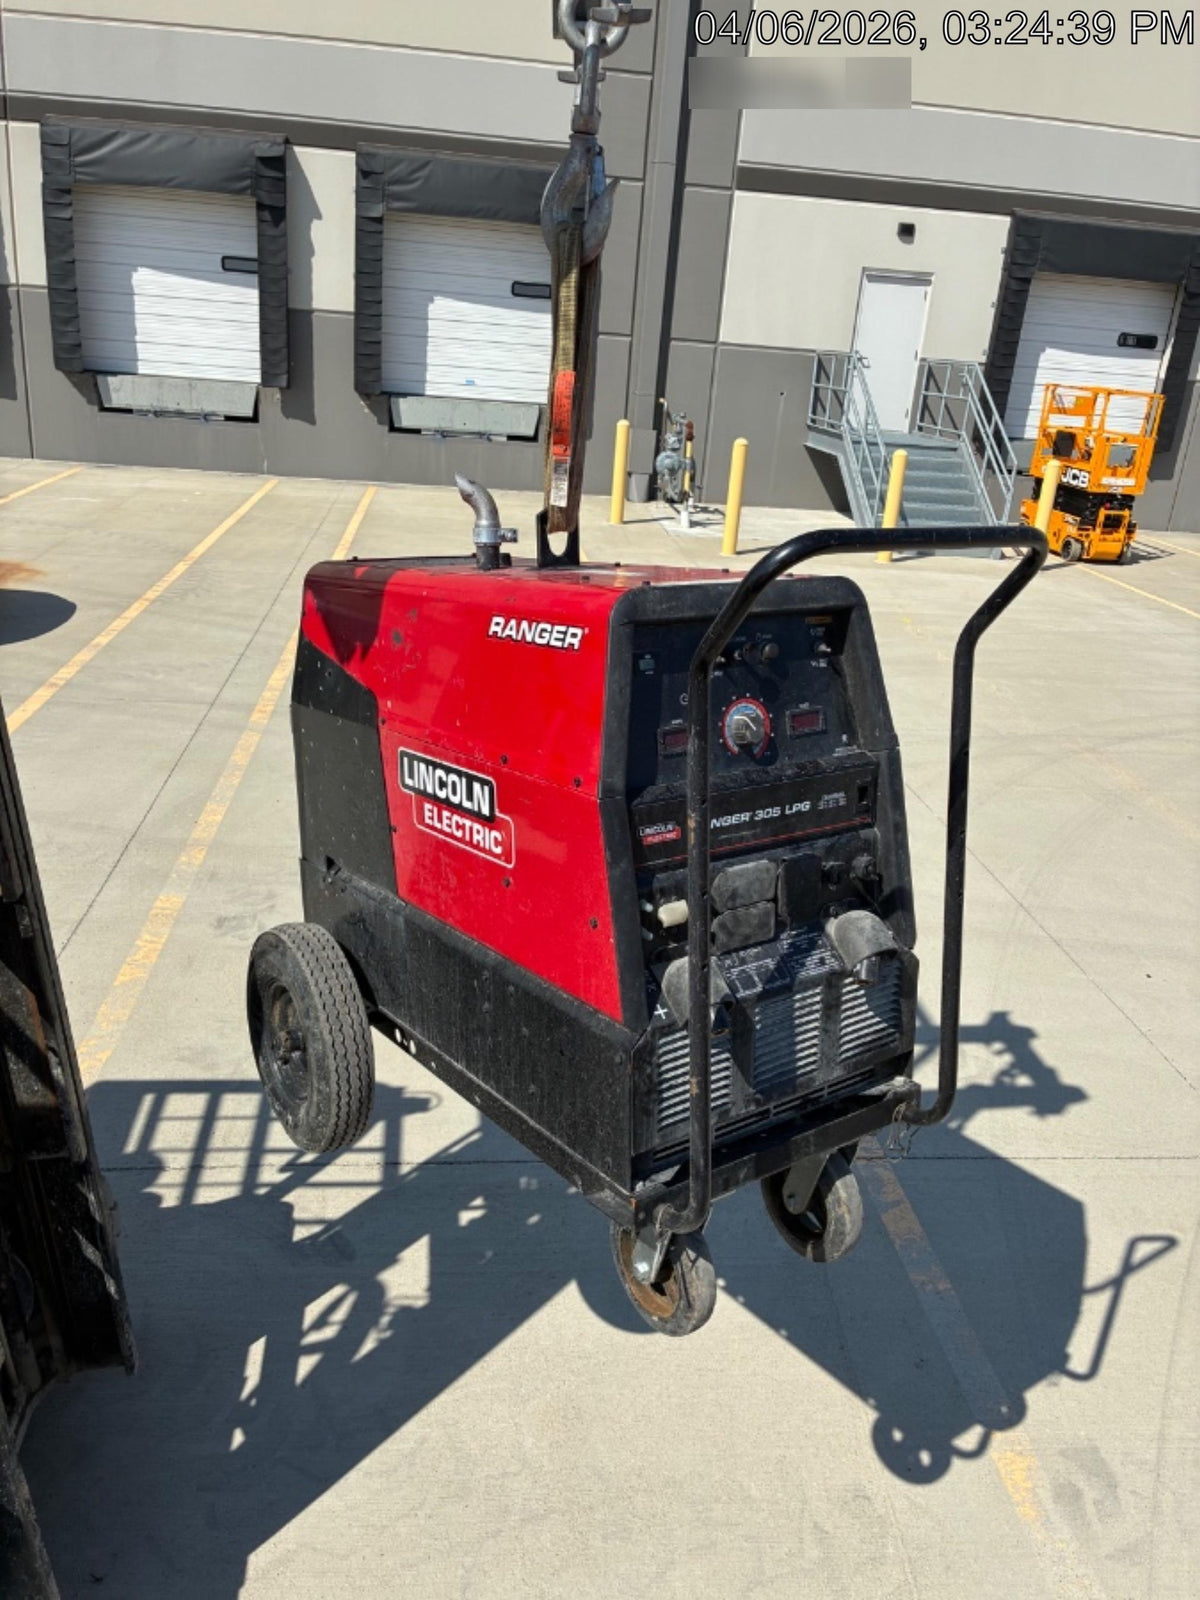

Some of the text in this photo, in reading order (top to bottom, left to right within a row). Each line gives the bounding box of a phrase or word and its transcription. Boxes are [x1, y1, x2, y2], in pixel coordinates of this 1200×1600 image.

[1061, 467, 1089, 488] JCB
[403, 757, 490, 816] LINCOLN
[423, 802, 502, 854] ELECTRIC
[710, 811, 751, 829] NGER
[754, 806, 781, 821] 305
[785, 800, 811, 815] LPG
